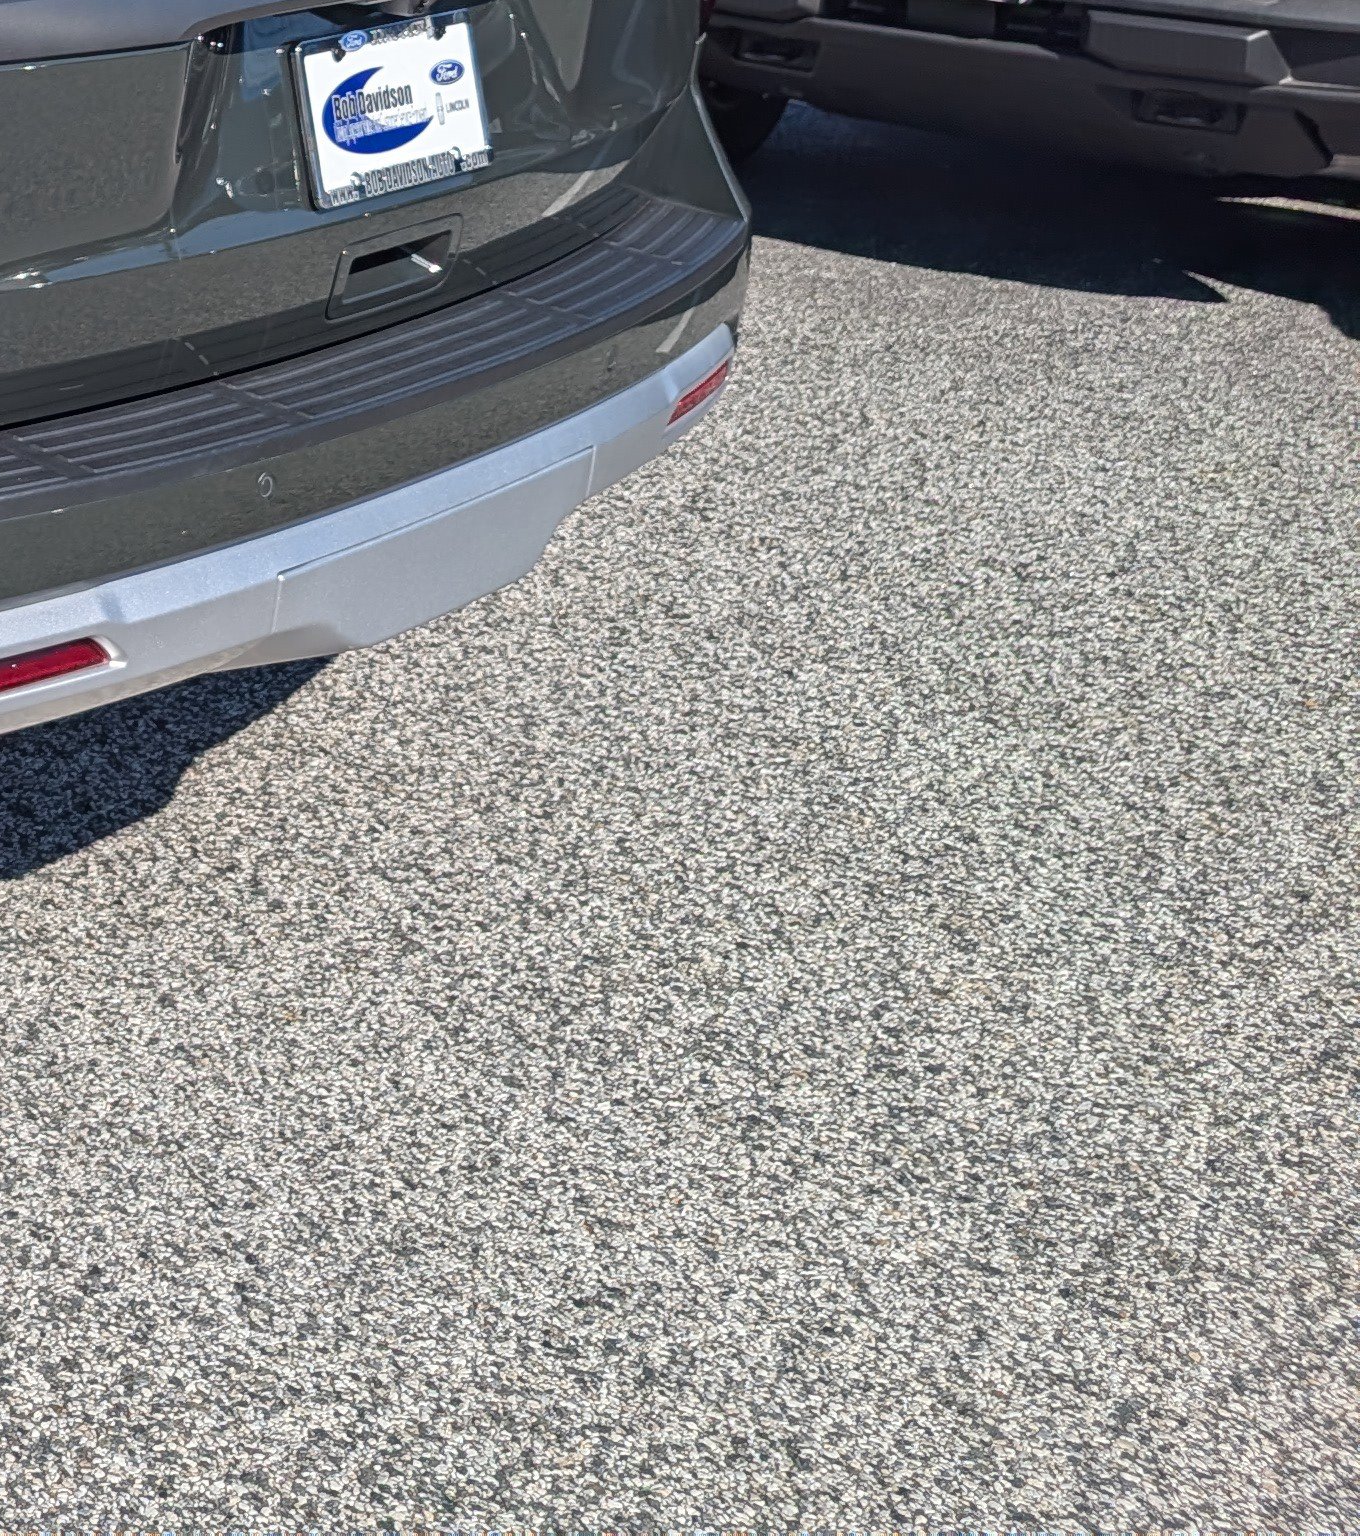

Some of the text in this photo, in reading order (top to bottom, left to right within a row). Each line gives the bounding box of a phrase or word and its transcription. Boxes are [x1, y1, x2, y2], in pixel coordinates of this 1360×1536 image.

[434, 64, 459, 82] Ford
[333, 84, 414, 121] Bob Davidson
[445, 98, 470, 114] LINCOLN
